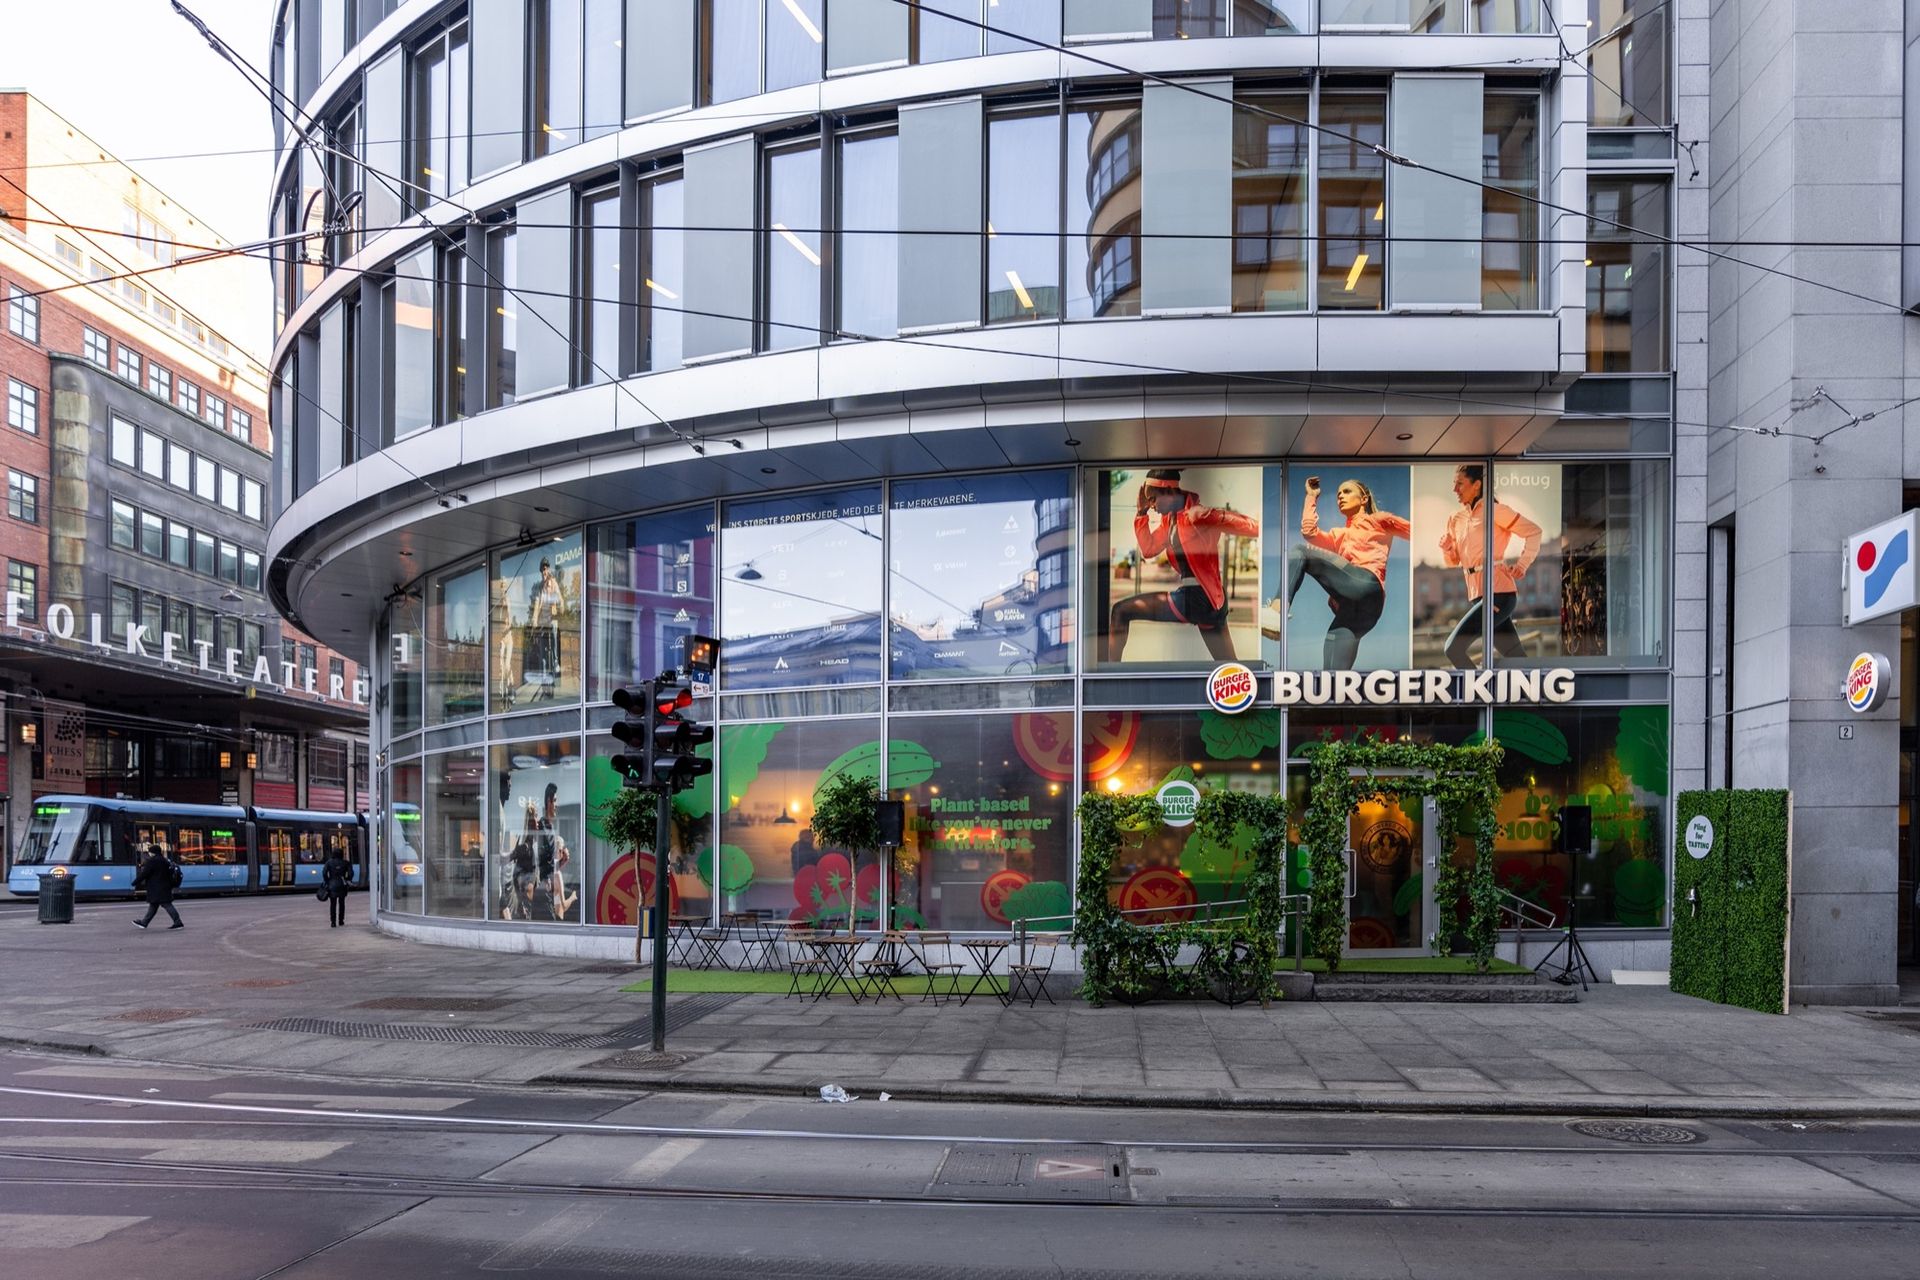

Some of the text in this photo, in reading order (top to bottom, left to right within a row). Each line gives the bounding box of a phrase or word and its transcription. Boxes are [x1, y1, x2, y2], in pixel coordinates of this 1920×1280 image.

[1494, 471, 1551, 490] johaug
[779, 510, 840, 524] SPORTSKJEDE,
[842, 507, 861, 517] MED
[863, 505, 877, 515] DE
[907, 493, 976, 510] MERKEVARENE.
[1213, 672, 1250, 690] BURGER
[1273, 667, 1576, 705] BURGER KING
[1847, 671, 1873, 700] KING
[1215, 680, 1252, 702] KING
[1843, 727, 1849, 737] 2
[49, 744, 83, 758] CHESS
[930, 795, 1030, 813] Plant-based
[1162, 796, 1195, 804] BURGER
[1162, 804, 1195, 815] KING
[1002, 817, 1053, 831] never
[1688, 840, 1710, 850] TASTING
